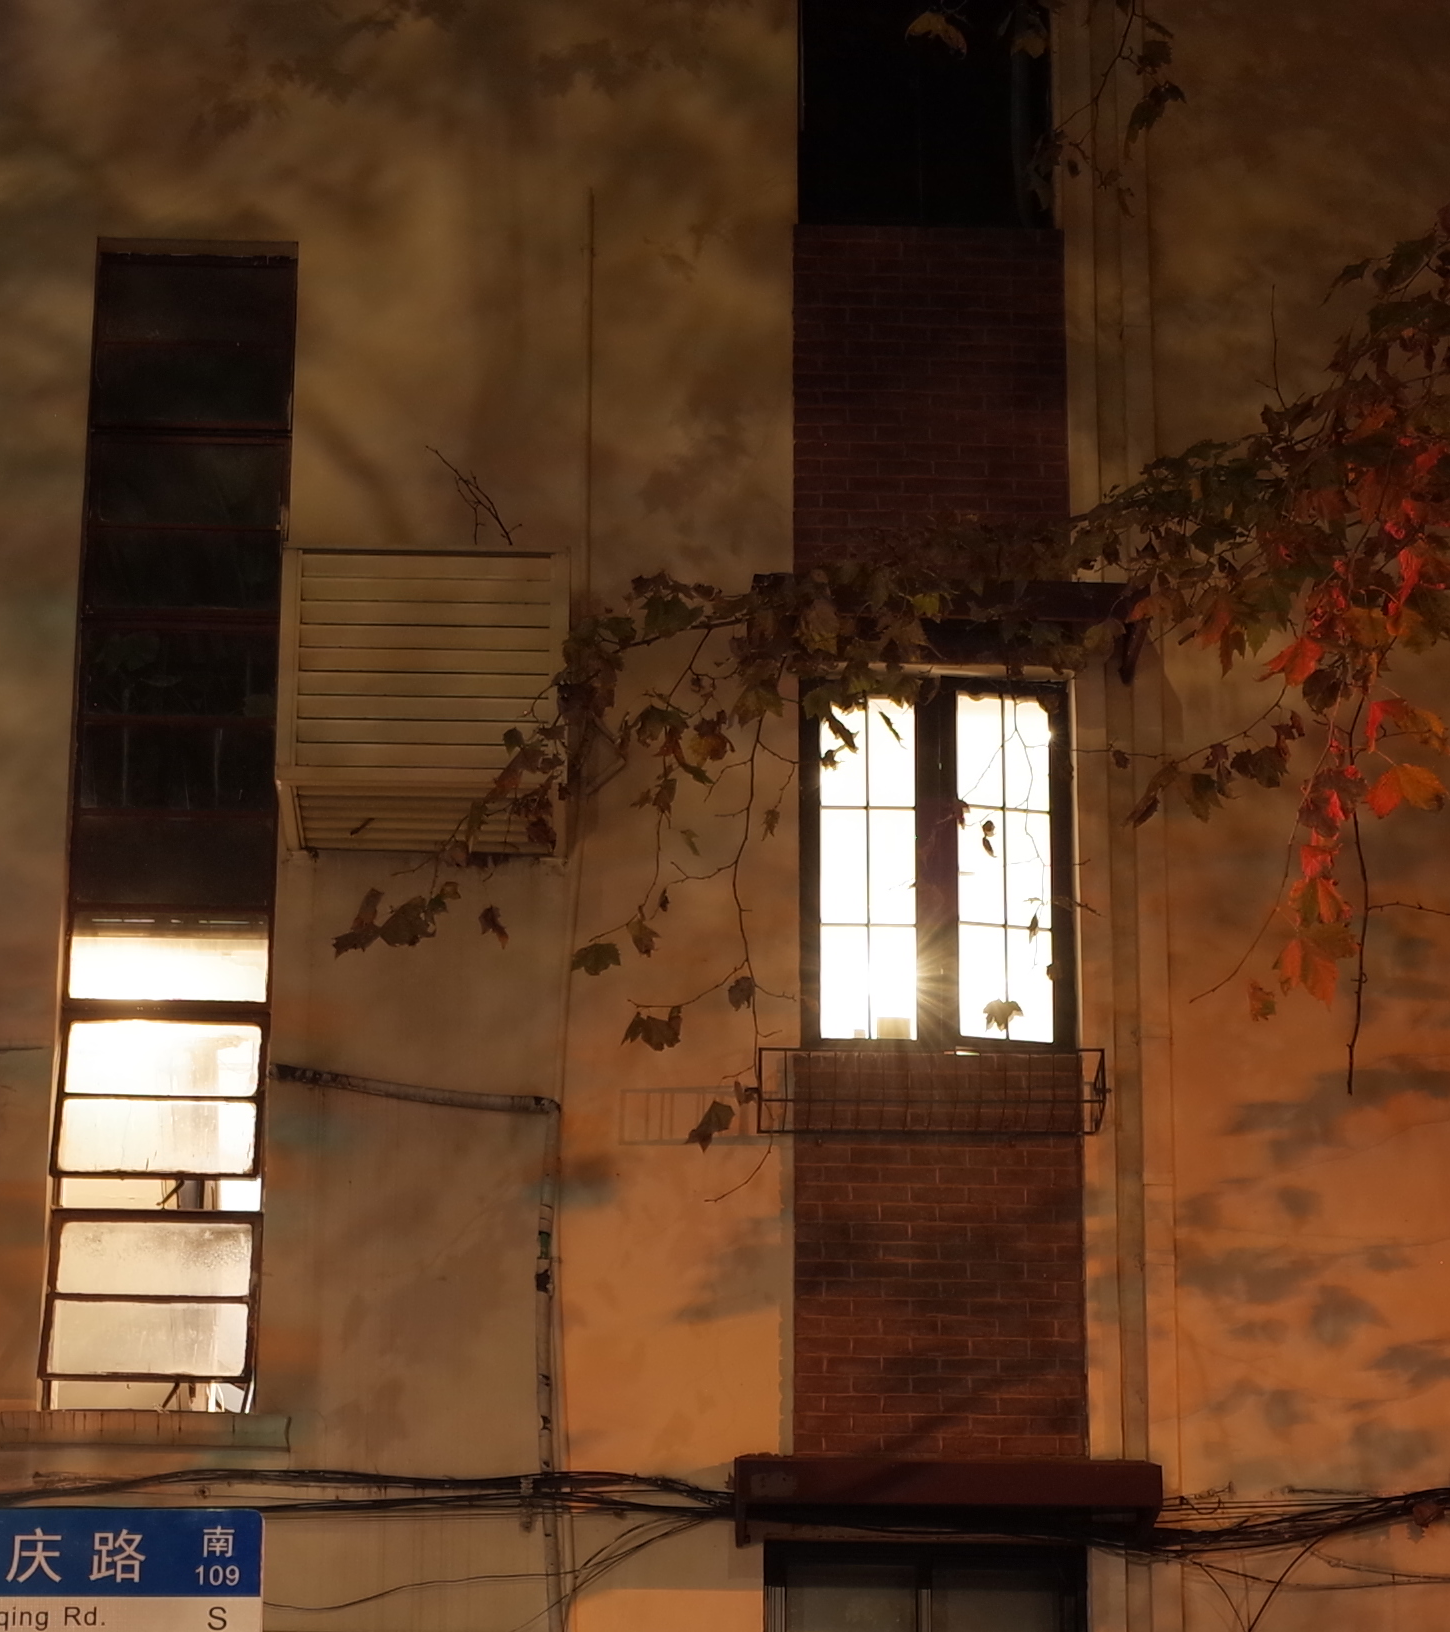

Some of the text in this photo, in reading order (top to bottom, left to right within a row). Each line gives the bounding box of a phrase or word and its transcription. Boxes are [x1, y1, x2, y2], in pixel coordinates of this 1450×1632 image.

[202, 1525, 234, 1559] 南
[194, 1565, 241, 1587] 109
[63, 1606, 106, 1626] Rd.
[207, 1606, 228, 1631] S
